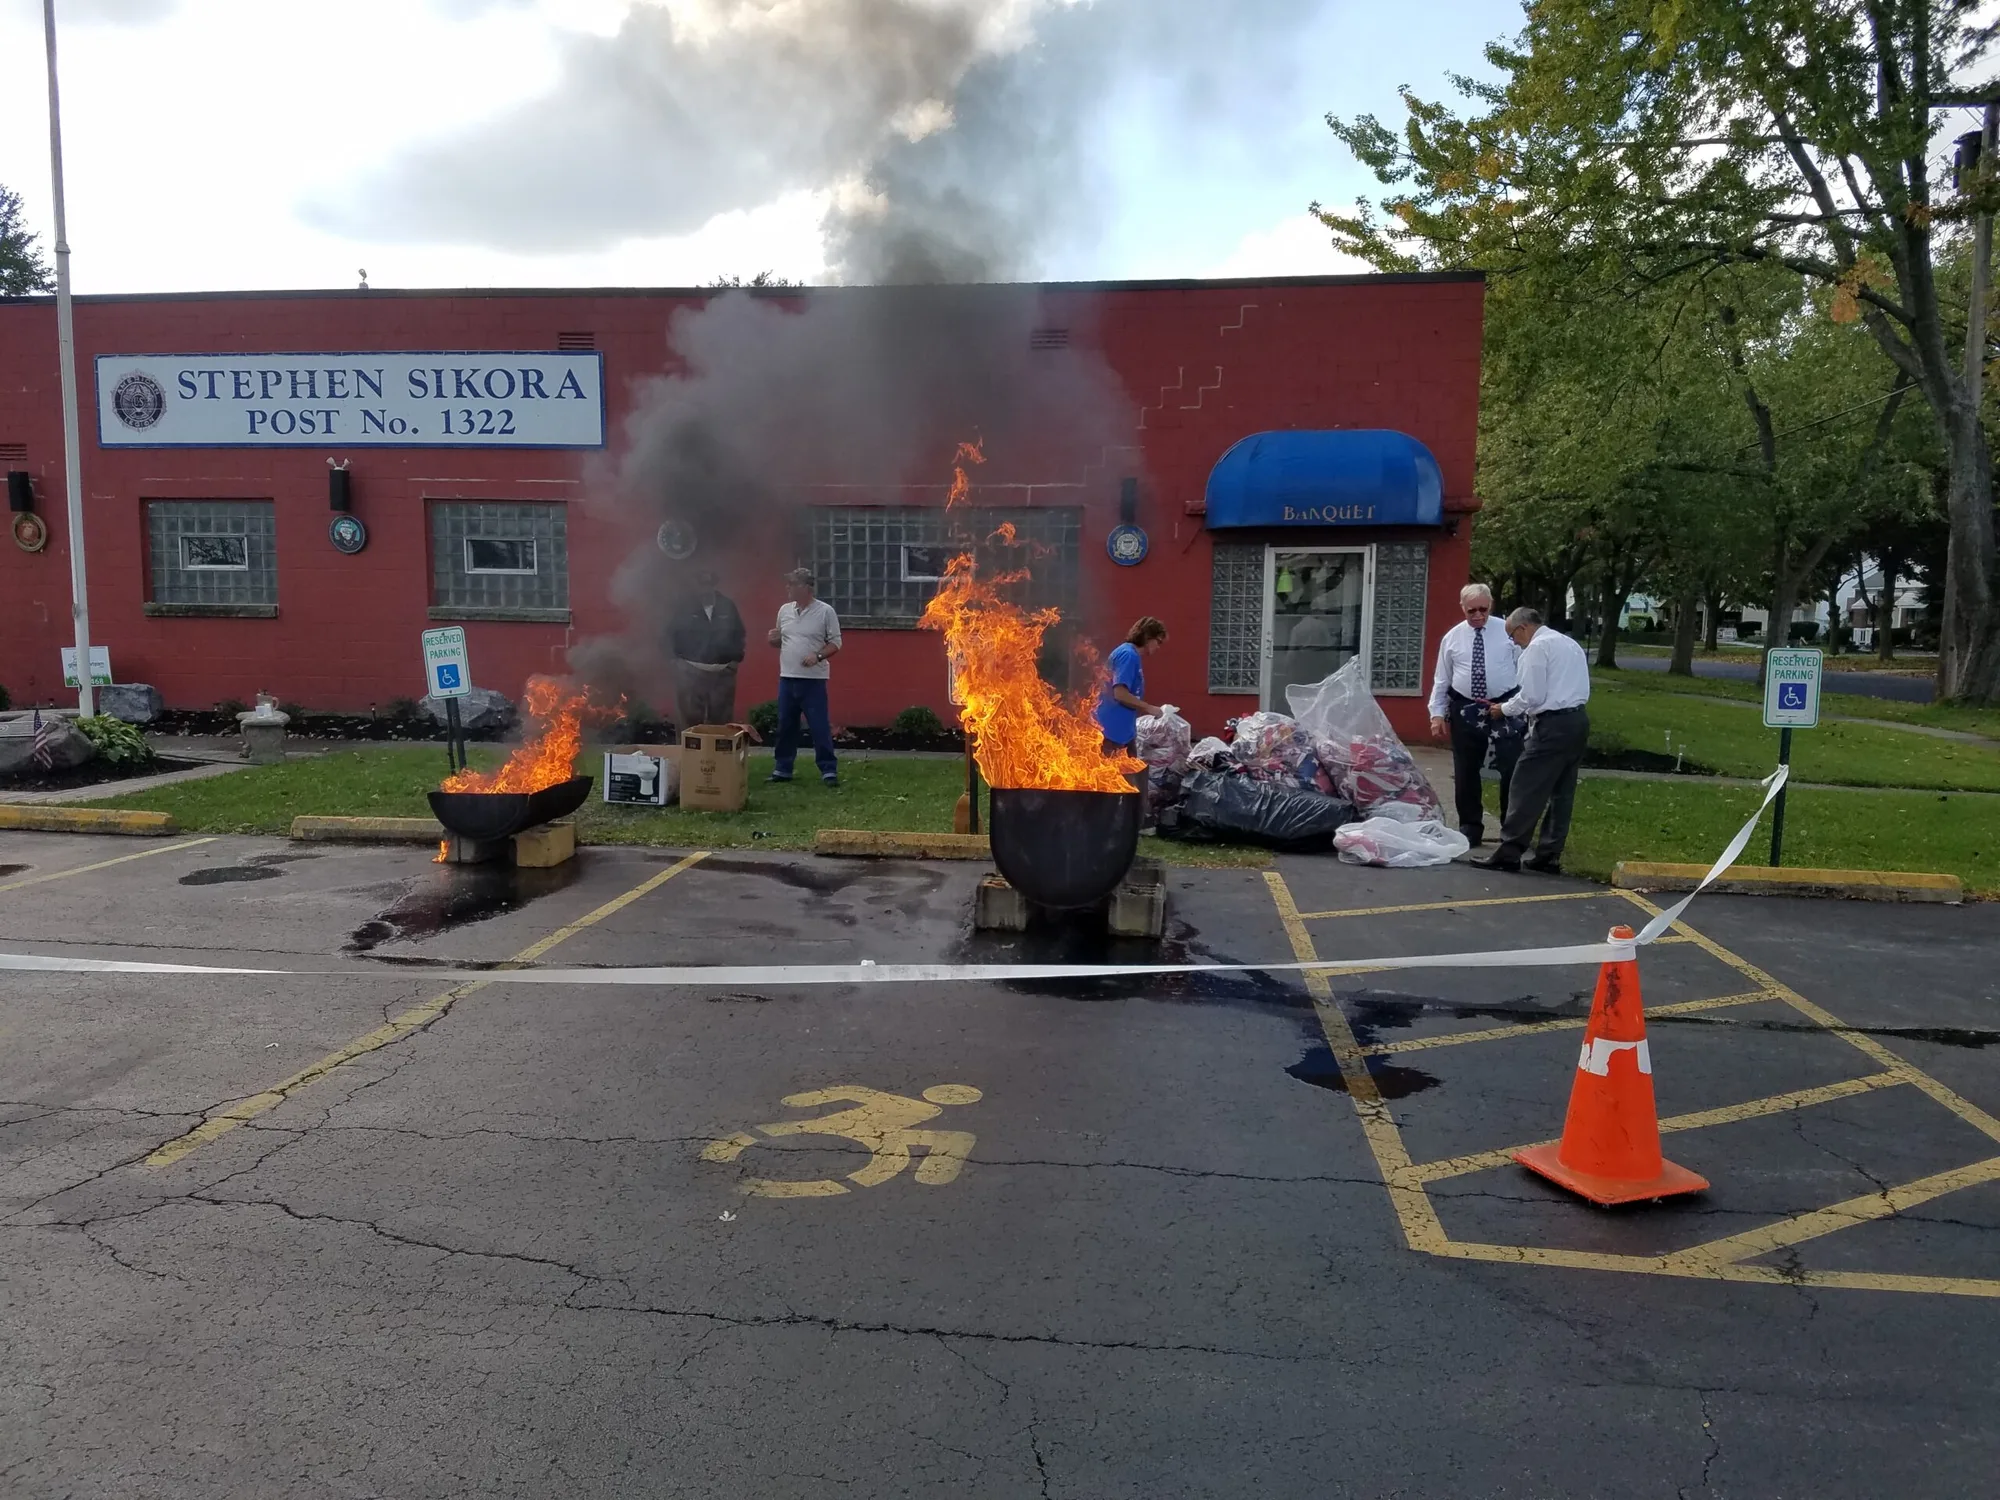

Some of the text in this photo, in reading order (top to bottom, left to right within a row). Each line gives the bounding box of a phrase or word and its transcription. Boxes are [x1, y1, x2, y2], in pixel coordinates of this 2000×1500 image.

[178, 368, 587, 399] STEPHEN SIKORA
[245, 409, 516, 434] POST No. 1322
[425, 634, 461, 646] RESERVED
[430, 647, 461, 659] PARKING
[1772, 656, 1818, 667] RESERVED
[1774, 669, 1814, 680] PARKING
